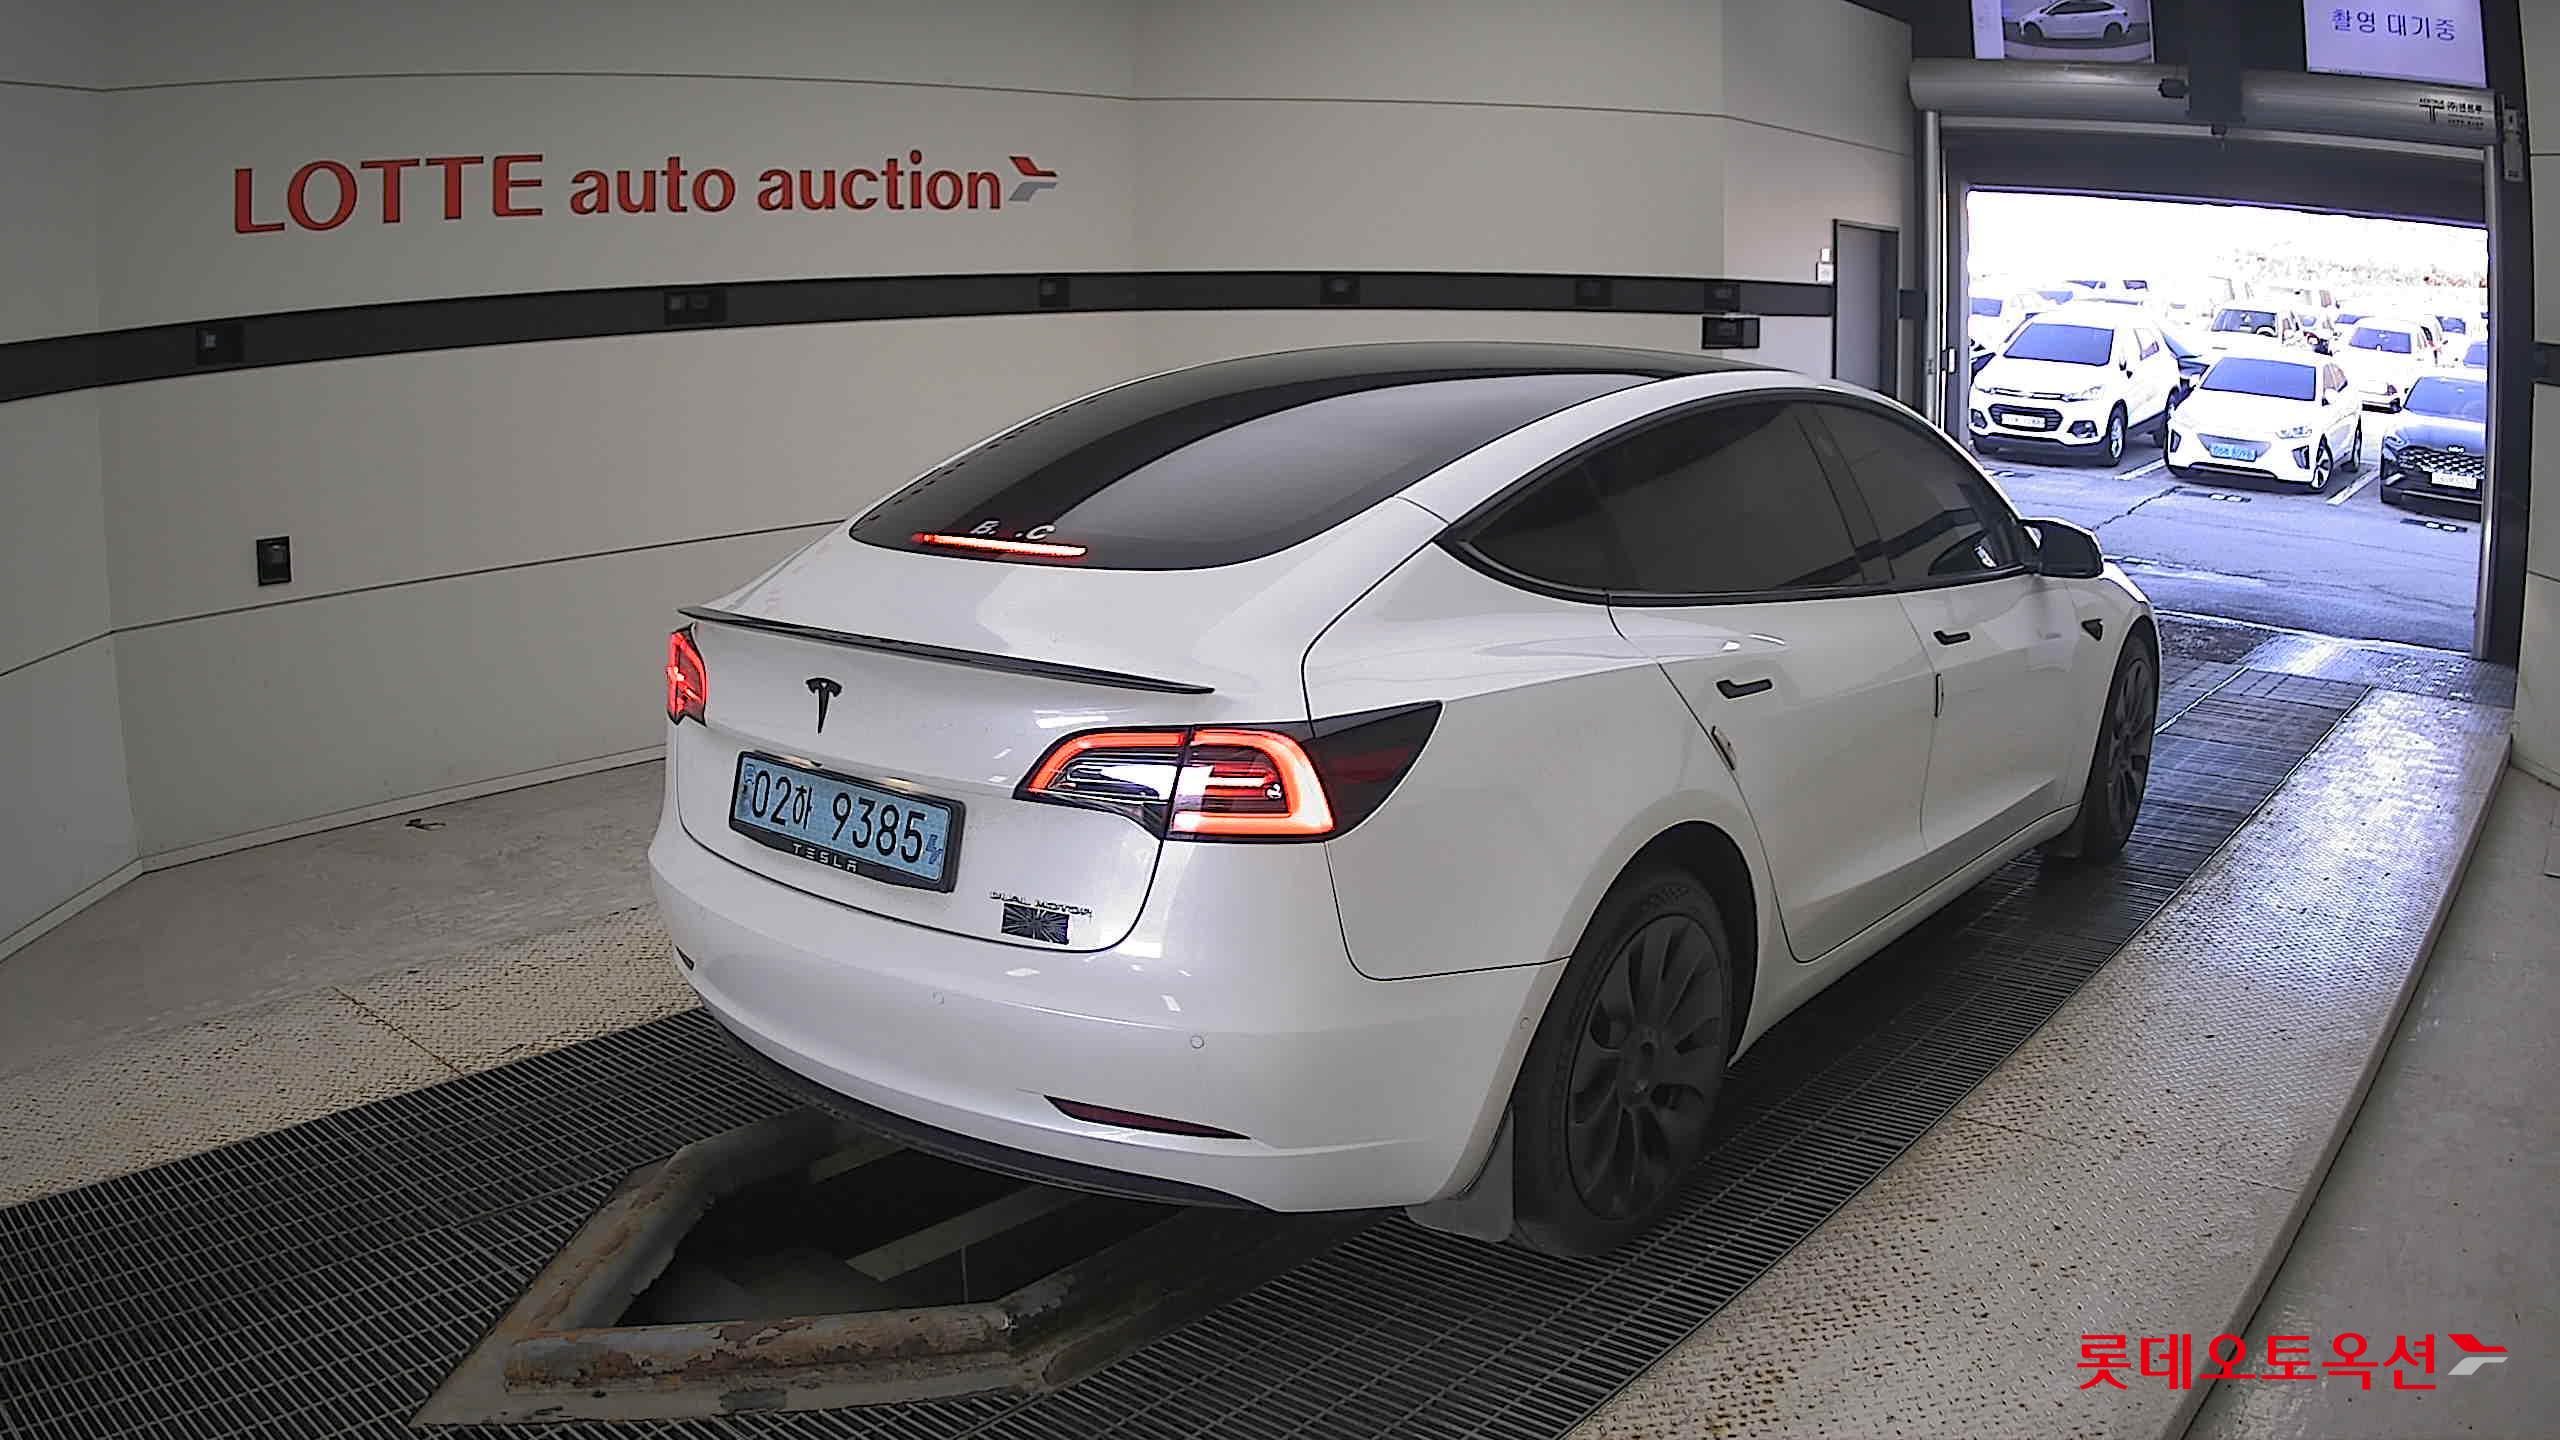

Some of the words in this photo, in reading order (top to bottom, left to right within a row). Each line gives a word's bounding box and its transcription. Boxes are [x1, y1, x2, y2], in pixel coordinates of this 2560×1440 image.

[2332, 9, 2376, 34] 촬영
[2387, 14, 2455, 41] 대기중
[235, 154, 543, 234] LOTTE
[570, 156, 736, 215] auto
[757, 149, 1001, 211] auction
[752, 769, 812, 830] 02하
[831, 792, 927, 863] 9385
[792, 843, 857, 873] TESLA
